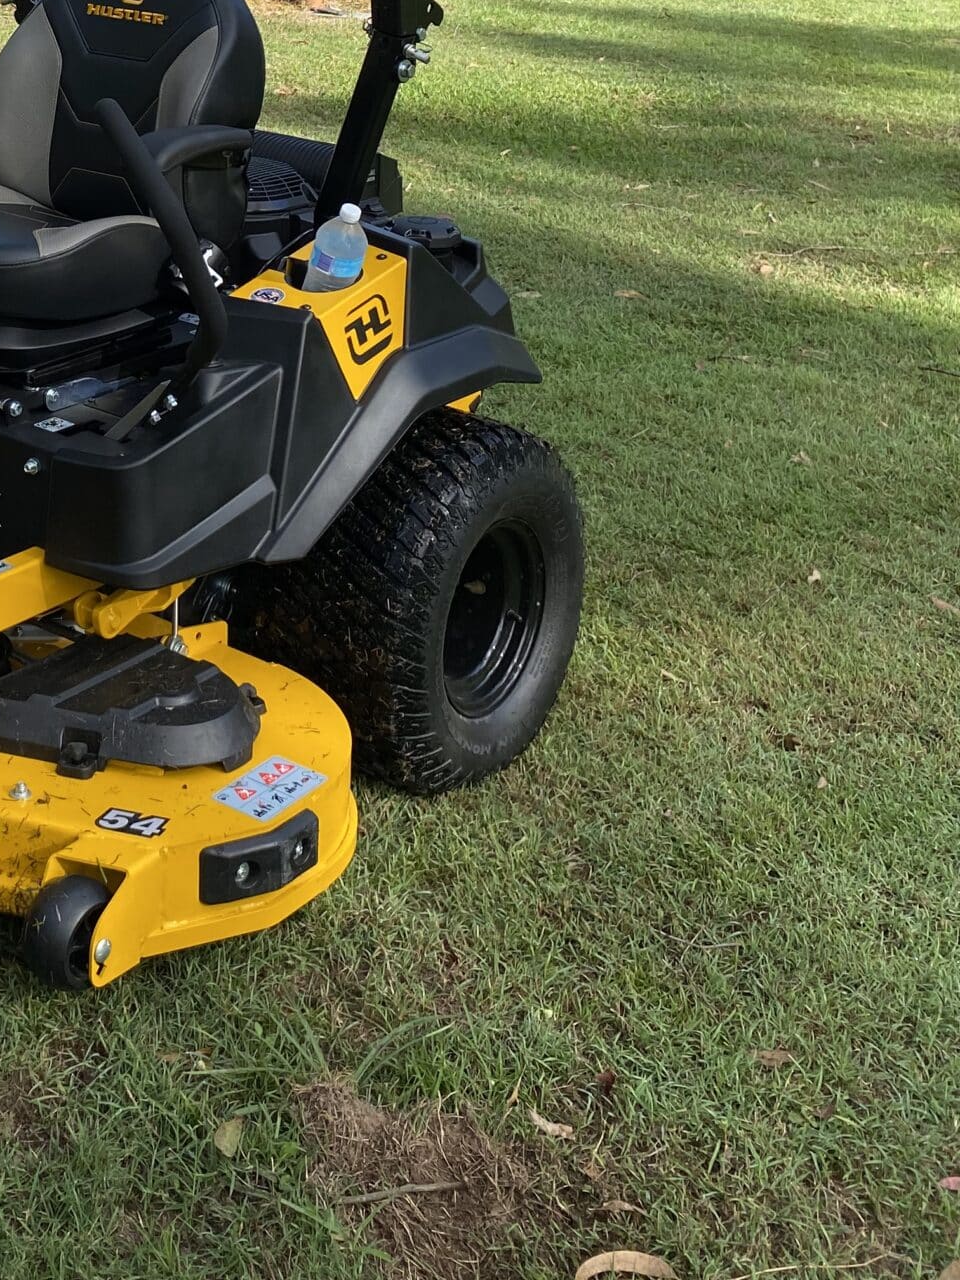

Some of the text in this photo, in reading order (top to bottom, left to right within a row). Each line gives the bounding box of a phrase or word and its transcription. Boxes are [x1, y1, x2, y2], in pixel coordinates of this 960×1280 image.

[86, 3, 166, 25] HUSTLER
[253, 289, 280, 303] USA
[97, 808, 168, 837] 54
